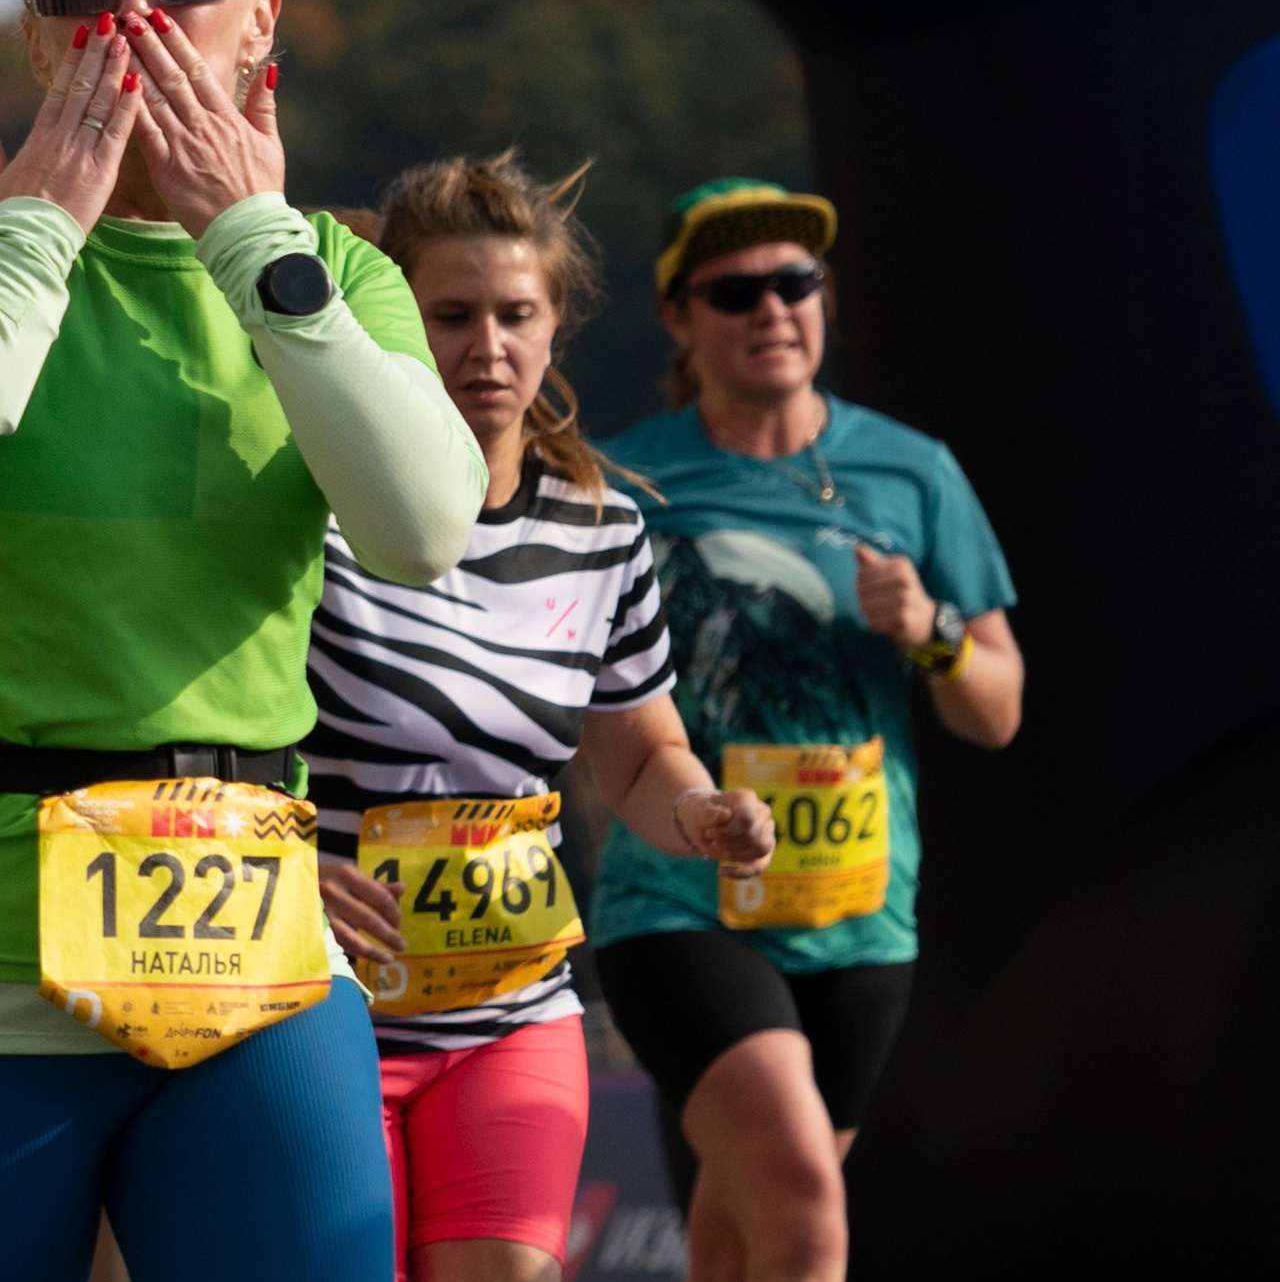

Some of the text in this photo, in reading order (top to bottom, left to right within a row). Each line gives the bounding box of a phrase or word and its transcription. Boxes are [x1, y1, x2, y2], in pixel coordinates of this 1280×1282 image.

[86, 852, 282, 942] 1227
[446, 925, 513, 948] ELENA
[131, 951, 242, 976] НАТАЛЬЯ
